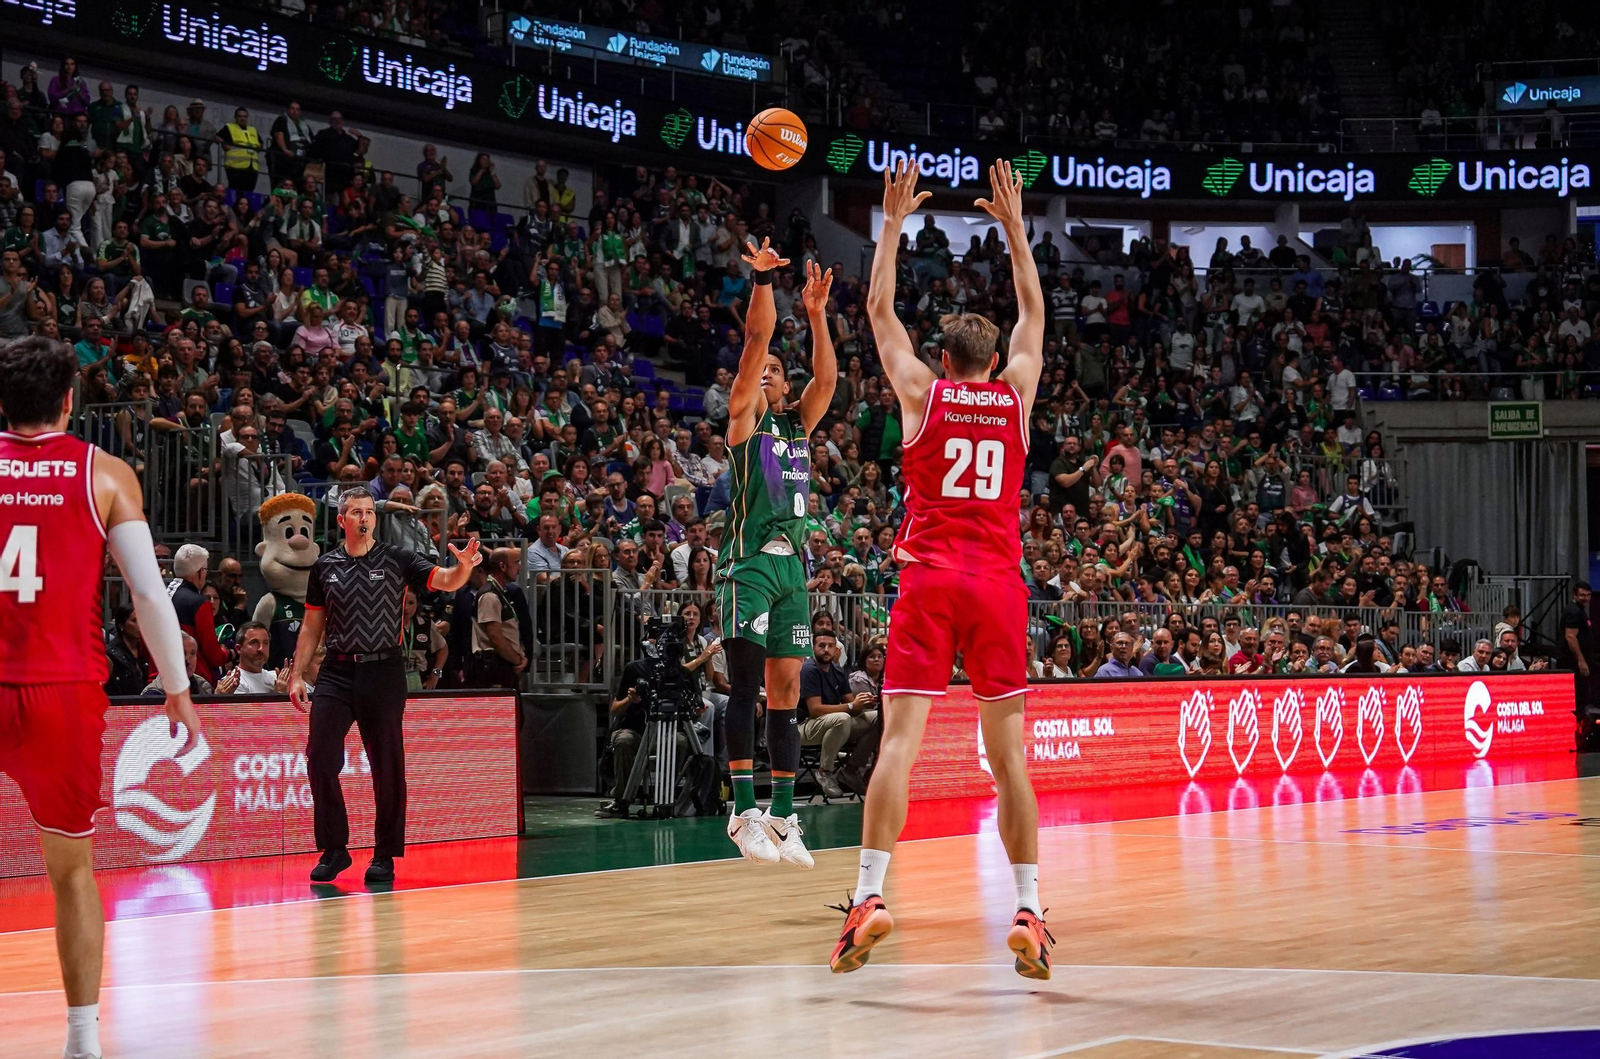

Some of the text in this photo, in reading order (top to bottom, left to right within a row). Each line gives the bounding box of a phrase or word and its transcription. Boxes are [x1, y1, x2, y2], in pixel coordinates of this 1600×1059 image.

[163, 4, 288, 71] Unicaja
[630, 36, 680, 56] Fundación
[722, 52, 770, 70] Fundación
[722, 62, 758, 80] Unicaja
[362, 46, 473, 110] Unicaja
[1529, 86, 1581, 102] Unicaja
[538, 84, 637, 143] Unicaja
[868, 140, 979, 189] Unicaja
[1052, 155, 1171, 199] Unicaja
[1249, 162, 1375, 202] Unicaja
[1458, 157, 1591, 198] Unicaja
[941, 384, 1014, 407] SUŠINSKAS
[944, 411, 1007, 426] Kave Home
[1492, 421, 1538, 432] EMERGENCIA
[1494, 409, 1535, 421] SALIDA DE
[941, 437, 1005, 500] 29
[16, 492, 64, 506] Home
[794, 492, 805, 517] 0
[1496, 700, 1544, 717] COSTA DEL SOL
[1033, 717, 1115, 740] COSTA DEL SOL
[1497, 716, 1525, 733] MÁLAGA
[1034, 739, 1081, 761] MÁLAGA
[233, 752, 308, 780] COSTA
[233, 780, 314, 813] MÁLAG
